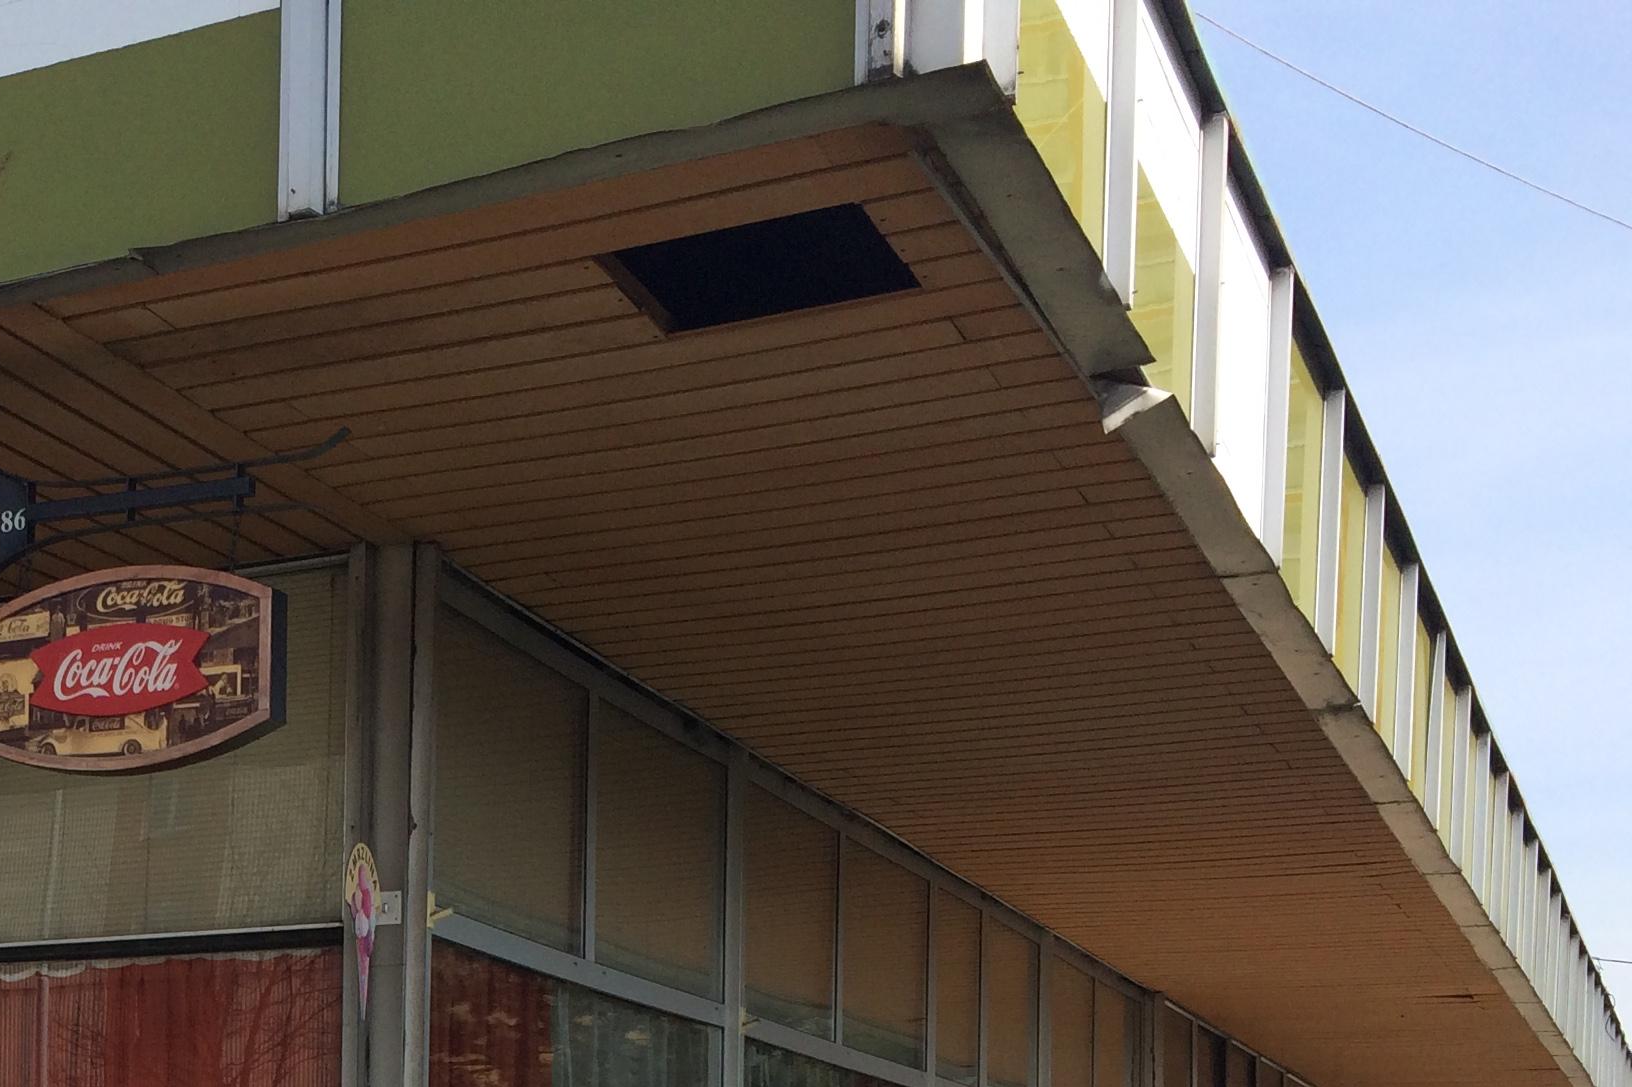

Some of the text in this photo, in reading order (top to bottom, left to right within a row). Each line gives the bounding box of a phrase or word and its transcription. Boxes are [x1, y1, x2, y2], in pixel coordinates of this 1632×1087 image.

[0, 508, 26, 533] 86
[96, 580, 187, 613] Coca-Cola
[91, 641, 122, 653] DRINK
[53, 639, 183, 701] Coca-Cola
